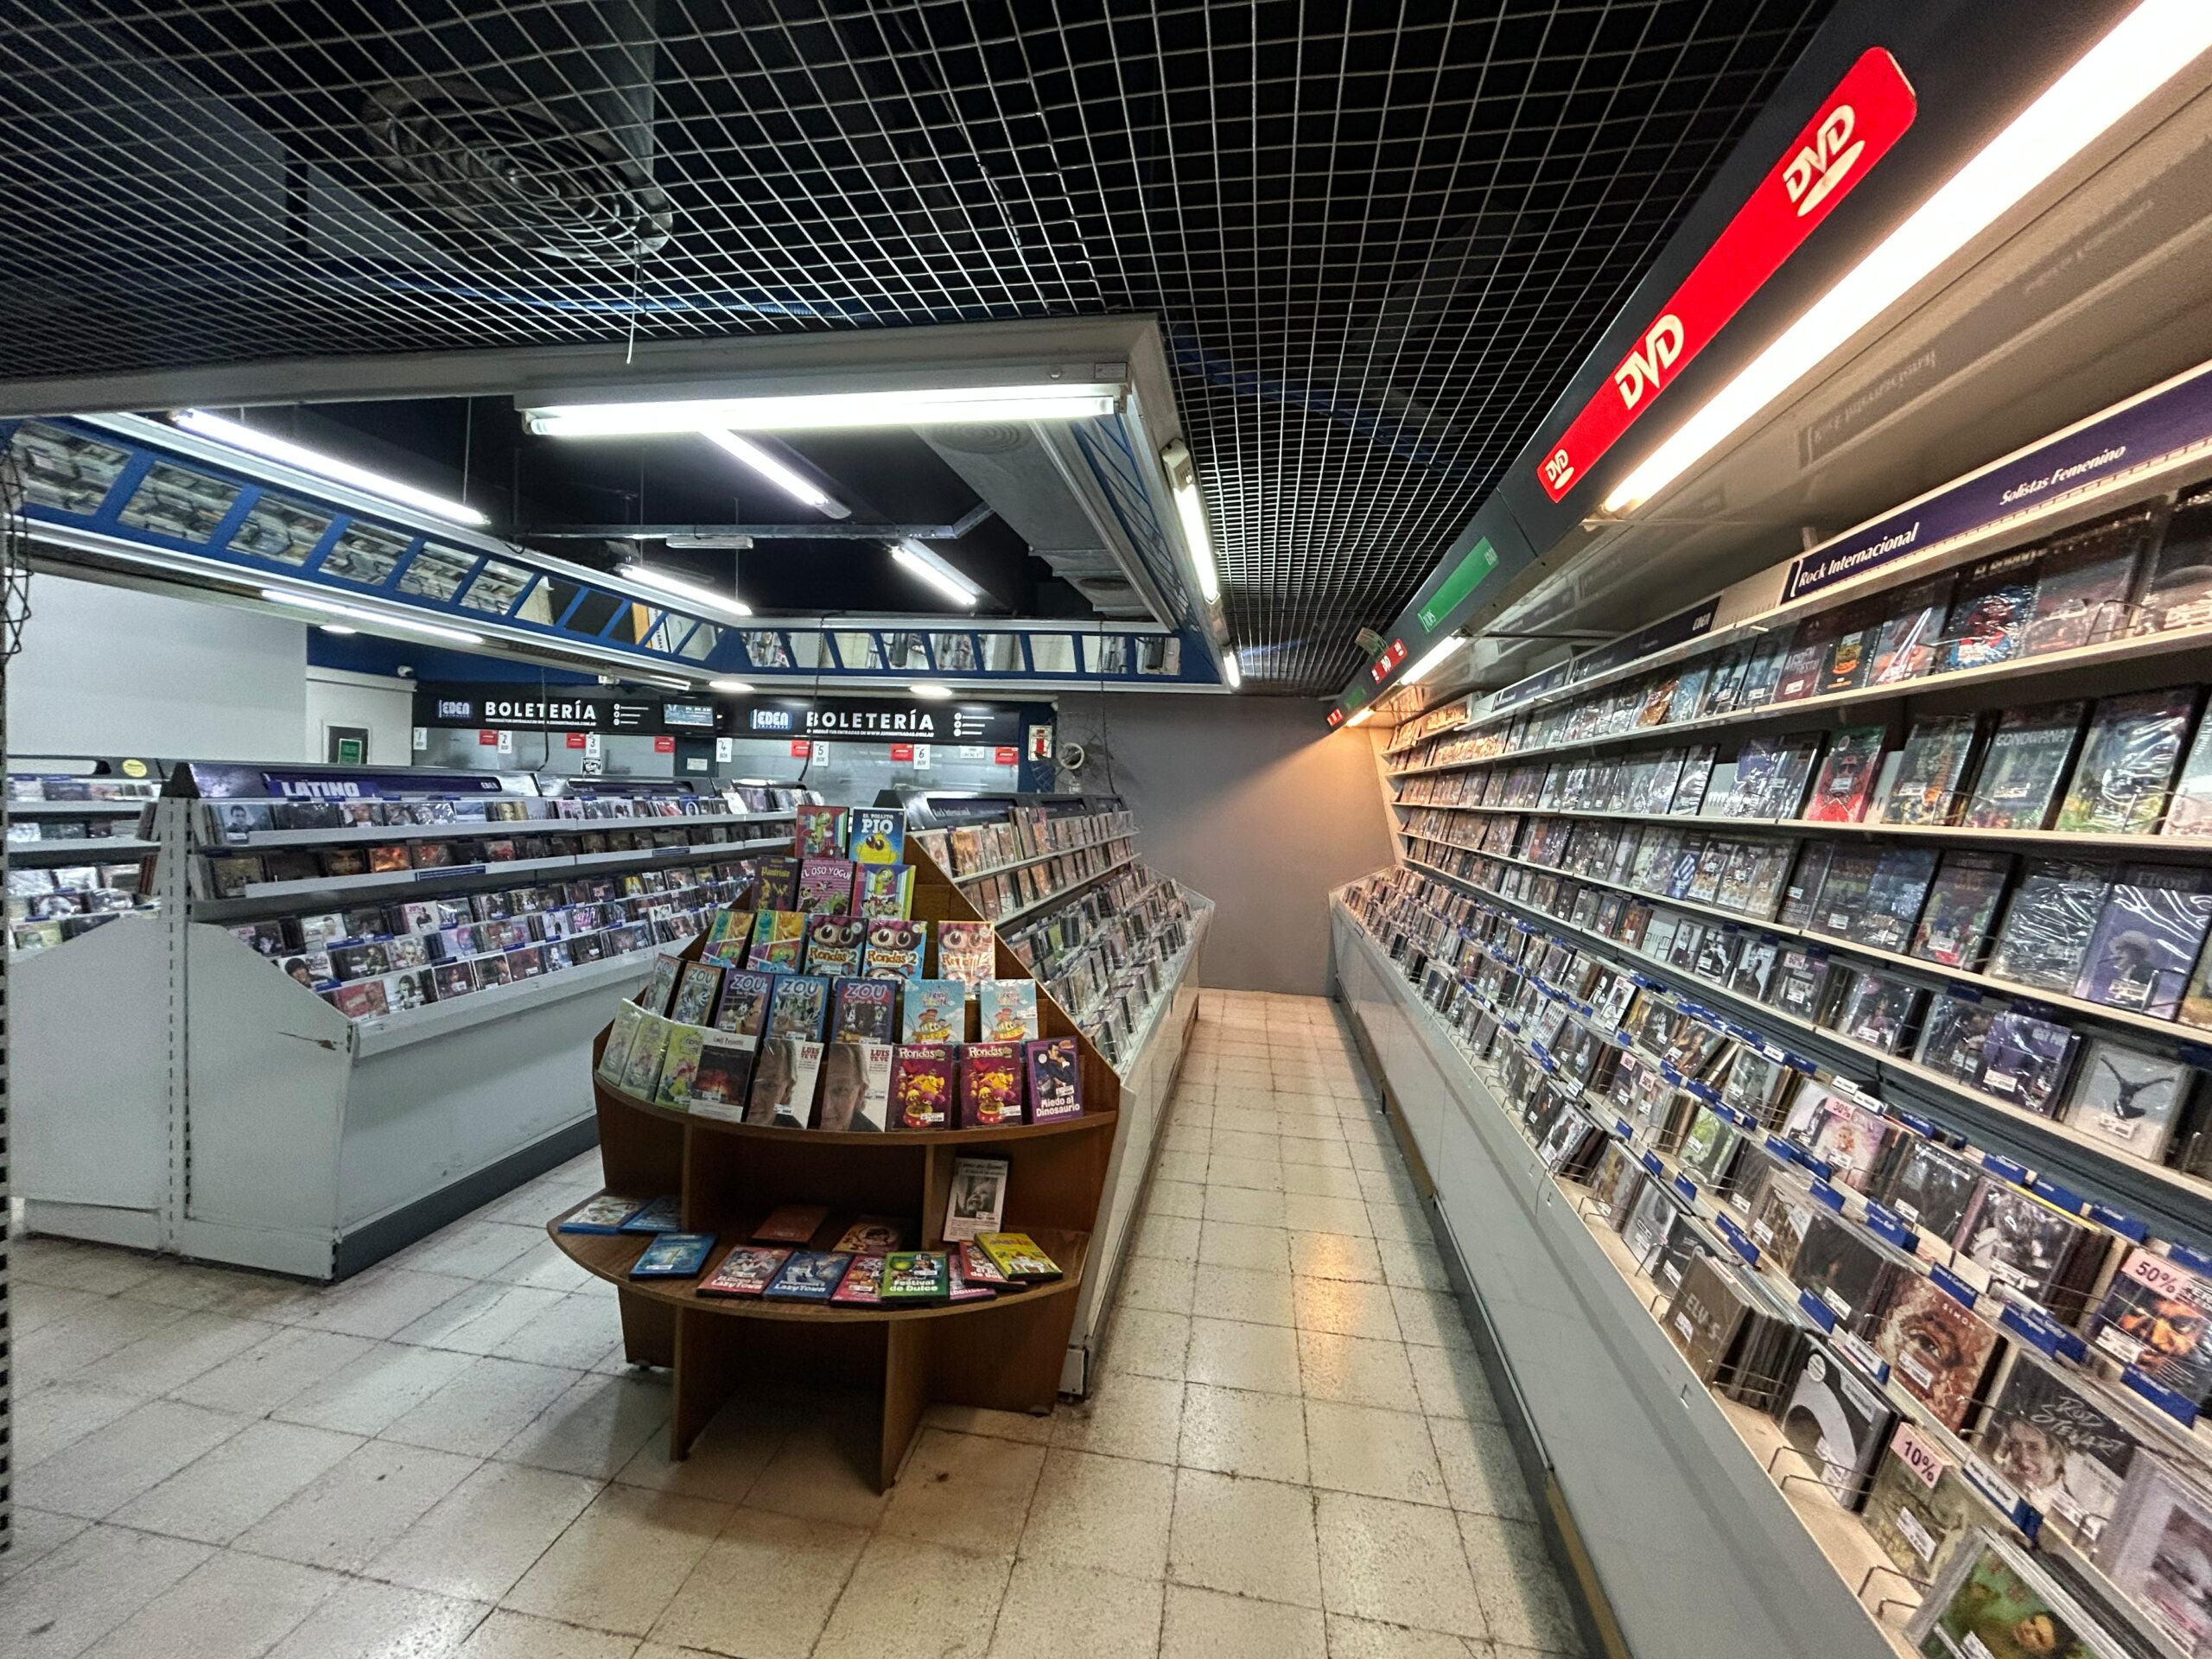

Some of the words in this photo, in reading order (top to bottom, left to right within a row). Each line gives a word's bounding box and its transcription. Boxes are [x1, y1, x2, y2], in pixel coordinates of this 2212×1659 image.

[1783, 105, 1855, 203] DVD
[1614, 314, 1684, 410] DVD
[1545, 448, 1569, 483] DVD
[1999, 476, 2049, 506] Solistas
[2051, 445, 2126, 486] Femenino
[1799, 566, 1826, 588] Rock
[1827, 522, 1920, 573] Internacional
[442, 702, 470, 715] EDEN
[485, 699, 596, 719] BOLETERÍA
[757, 711, 789, 726] EDEN
[806, 709, 934, 730] BOLETERÍA
[817, 745, 824, 756] 5
[918, 747, 925, 759] 6
[281, 779, 359, 798] LATINO
[861, 819, 893, 835] PIO
[801, 868, 810, 879] EL
[811, 867, 827, 875] OSO
[829, 867, 852, 880] YOGUI
[810, 947, 846, 963] Rondas
[848, 950, 857, 963] 2
[868, 950, 906, 965] Rondas
[908, 953, 918, 964] 2
[688, 969, 714, 984] ZOU
[732, 975, 766, 991] ZOU
[783, 979, 818, 995] ZOU
[844, 982, 887, 1001] ZOU
[802, 1046, 820, 1055] LUIS
[899, 1046, 935, 1059] Rondas
[969, 1046, 1004, 1058] Rondas
[1036, 1103, 1080, 1117] Dinosaurio
[1041, 1096, 1065, 1109] Miedo
[1066, 1096, 1075, 1105] al
[1834, 1101, 1851, 1118] 30%
[711, 1279, 763, 1291] LazyTown
[2135, 1261, 2177, 1294] 50%
[774, 1282, 826, 1293] LazyTown
[1685, 1292, 1721, 1340] ELVS
[1904, 1440, 1935, 1483] 10%
